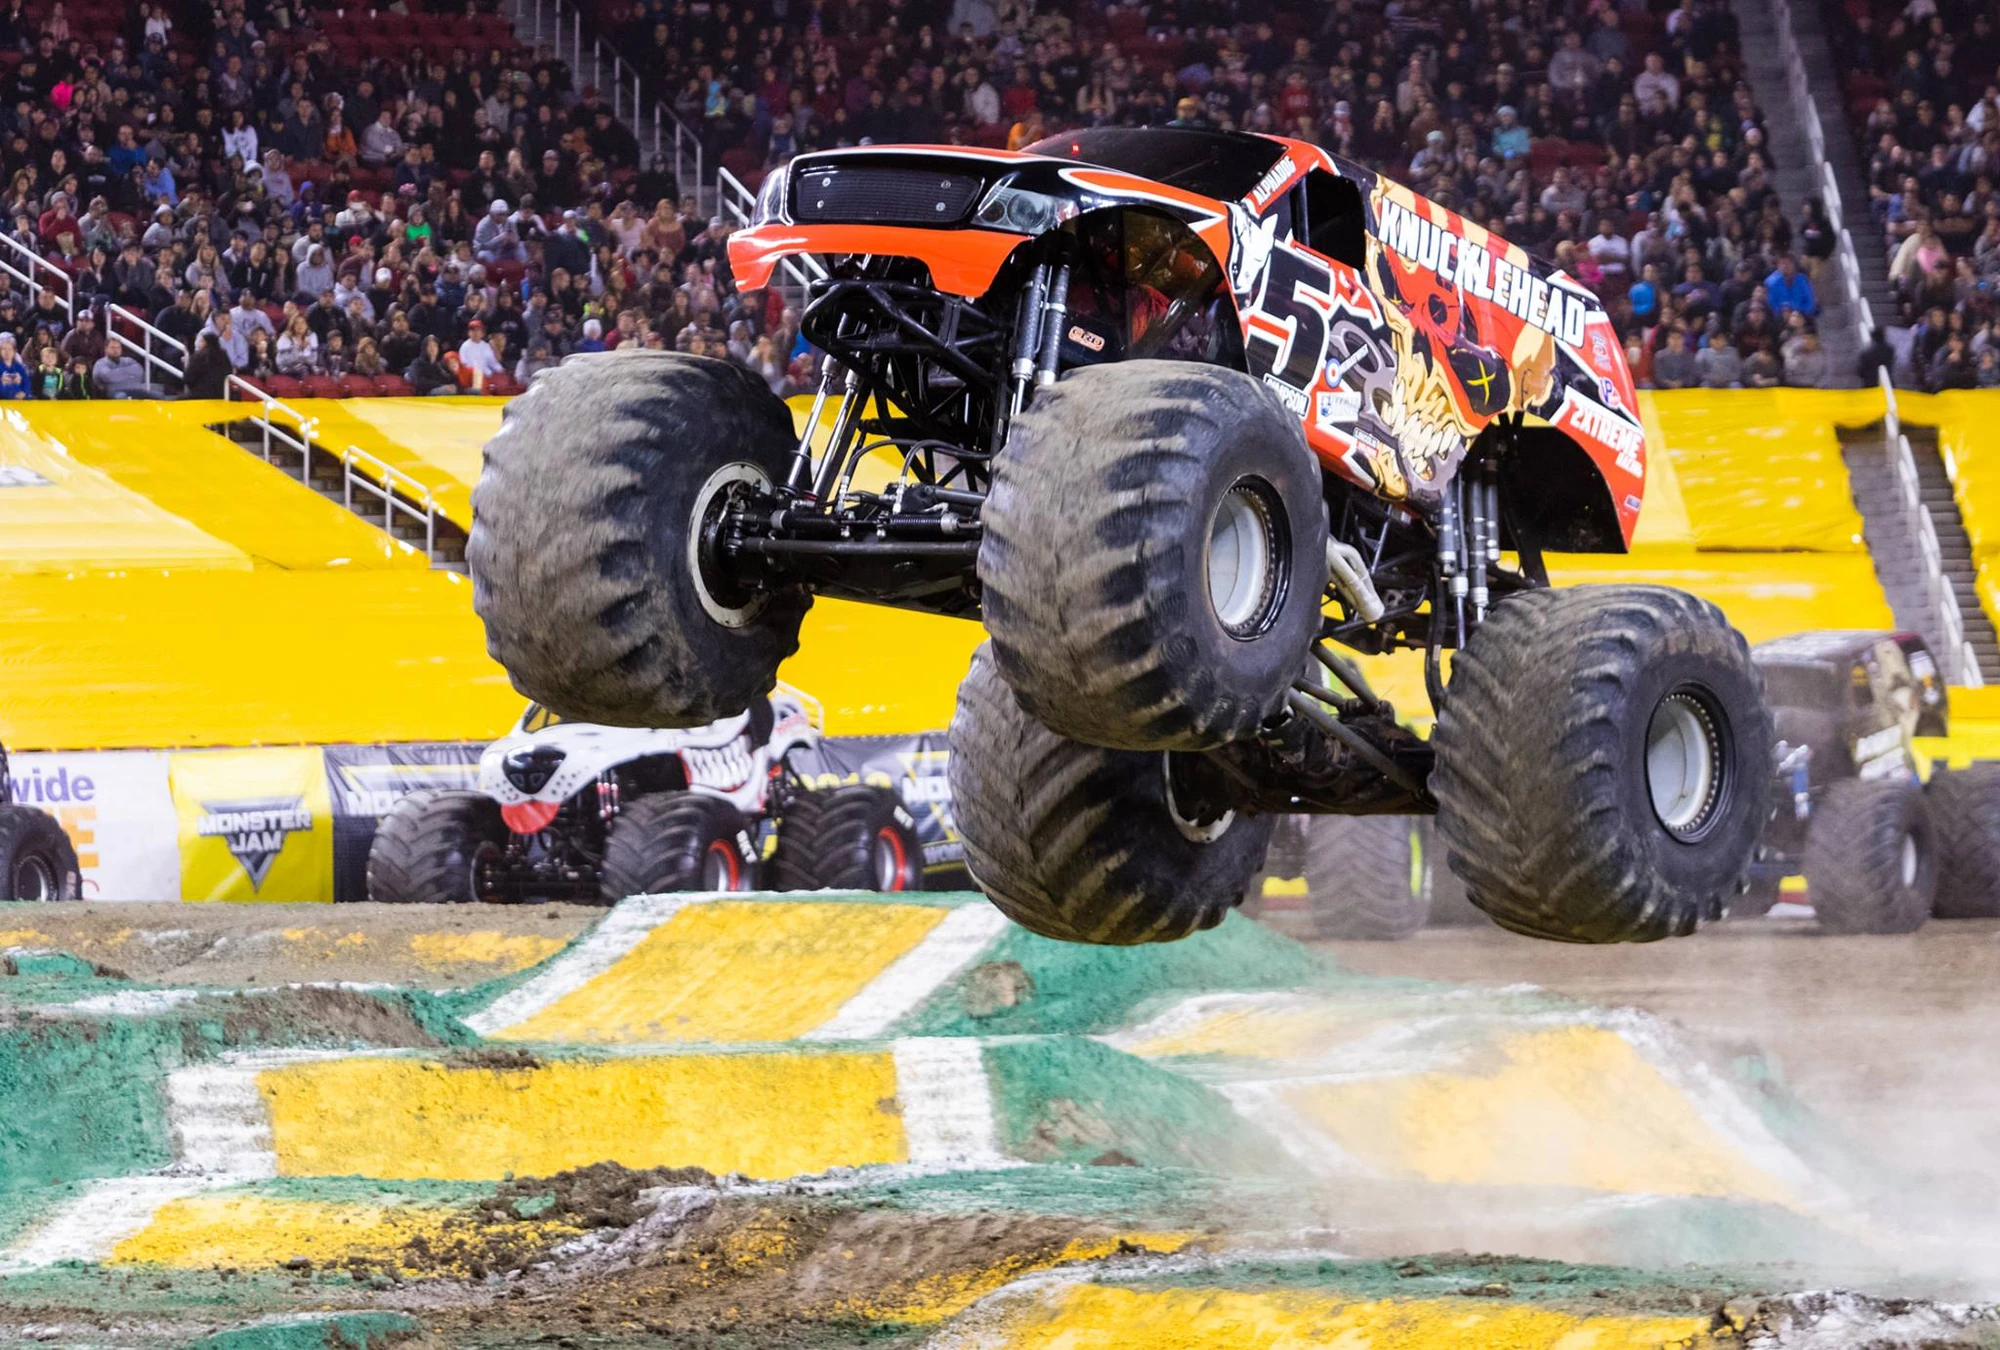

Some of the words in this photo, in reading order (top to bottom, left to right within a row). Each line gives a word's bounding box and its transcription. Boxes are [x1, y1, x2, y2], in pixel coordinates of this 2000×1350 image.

[1252, 155, 1297, 206] ALPHADOG
[1377, 196, 1586, 348] KNUCKLEHEAD
[1569, 404, 1642, 462] 2XTREME
[198, 808, 312, 835] MONSTER
[230, 830, 282, 853] JAM
